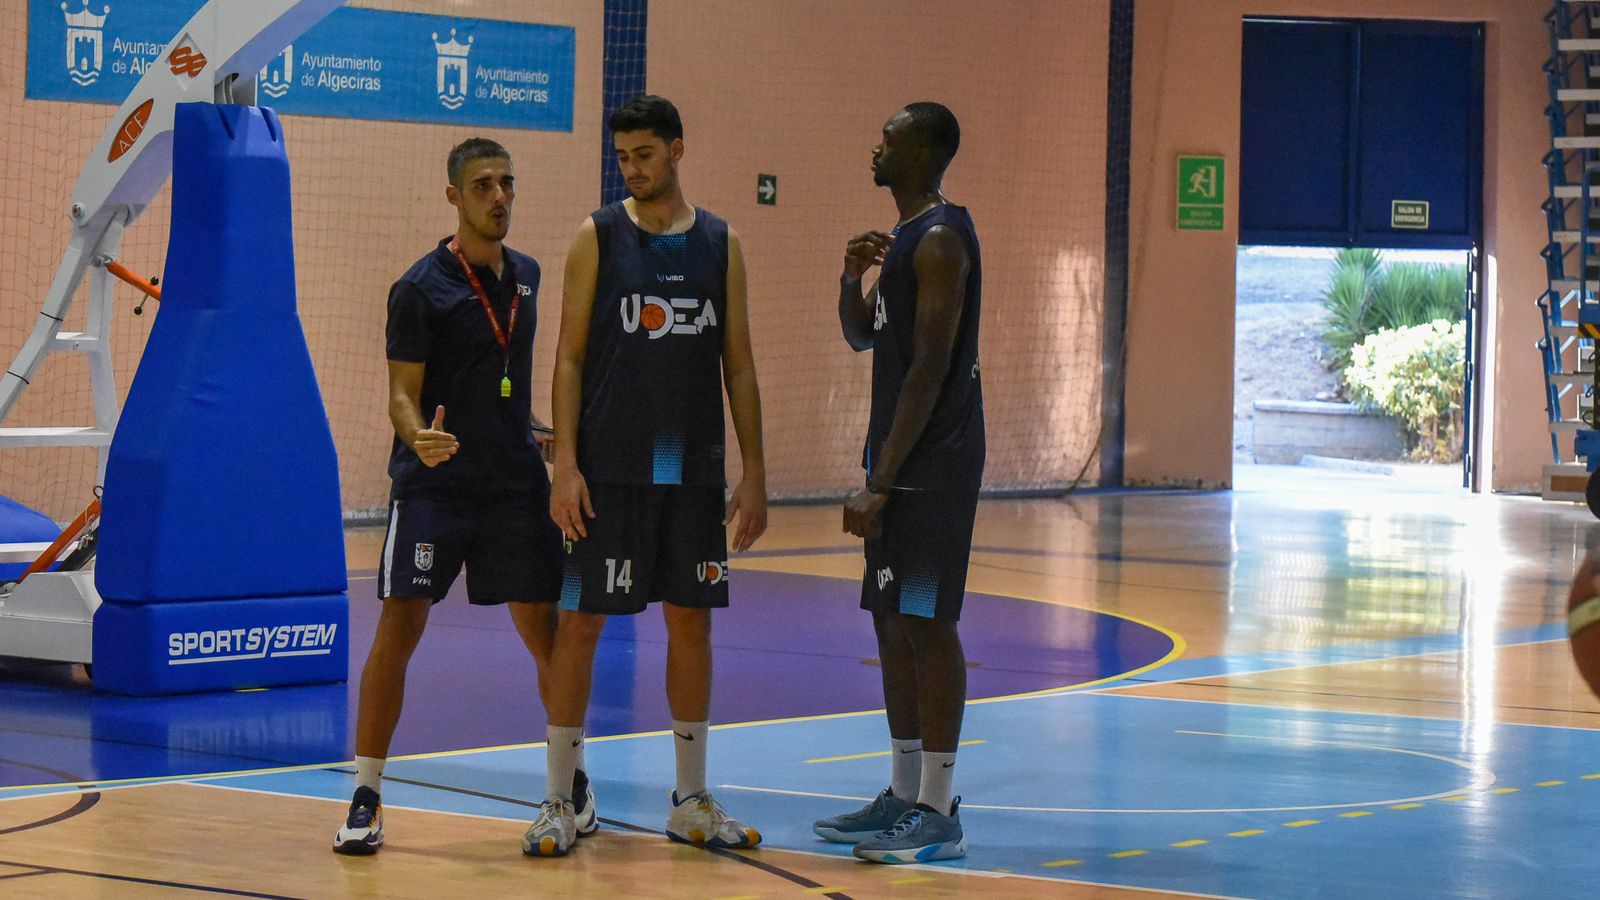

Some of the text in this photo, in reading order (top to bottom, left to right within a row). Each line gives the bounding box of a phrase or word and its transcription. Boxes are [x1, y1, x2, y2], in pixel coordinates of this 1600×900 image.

[112, 37, 168, 57] Ayuntam
[112, 60, 126, 74] de
[302, 52, 382, 72] Ayuntamiento
[301, 70, 381, 93] de Algeciras
[475, 64, 549, 85] Ayuntamiento
[475, 83, 549, 104] de Algeciras
[620, 293, 717, 339] UDEA
[605, 558, 632, 593] 14
